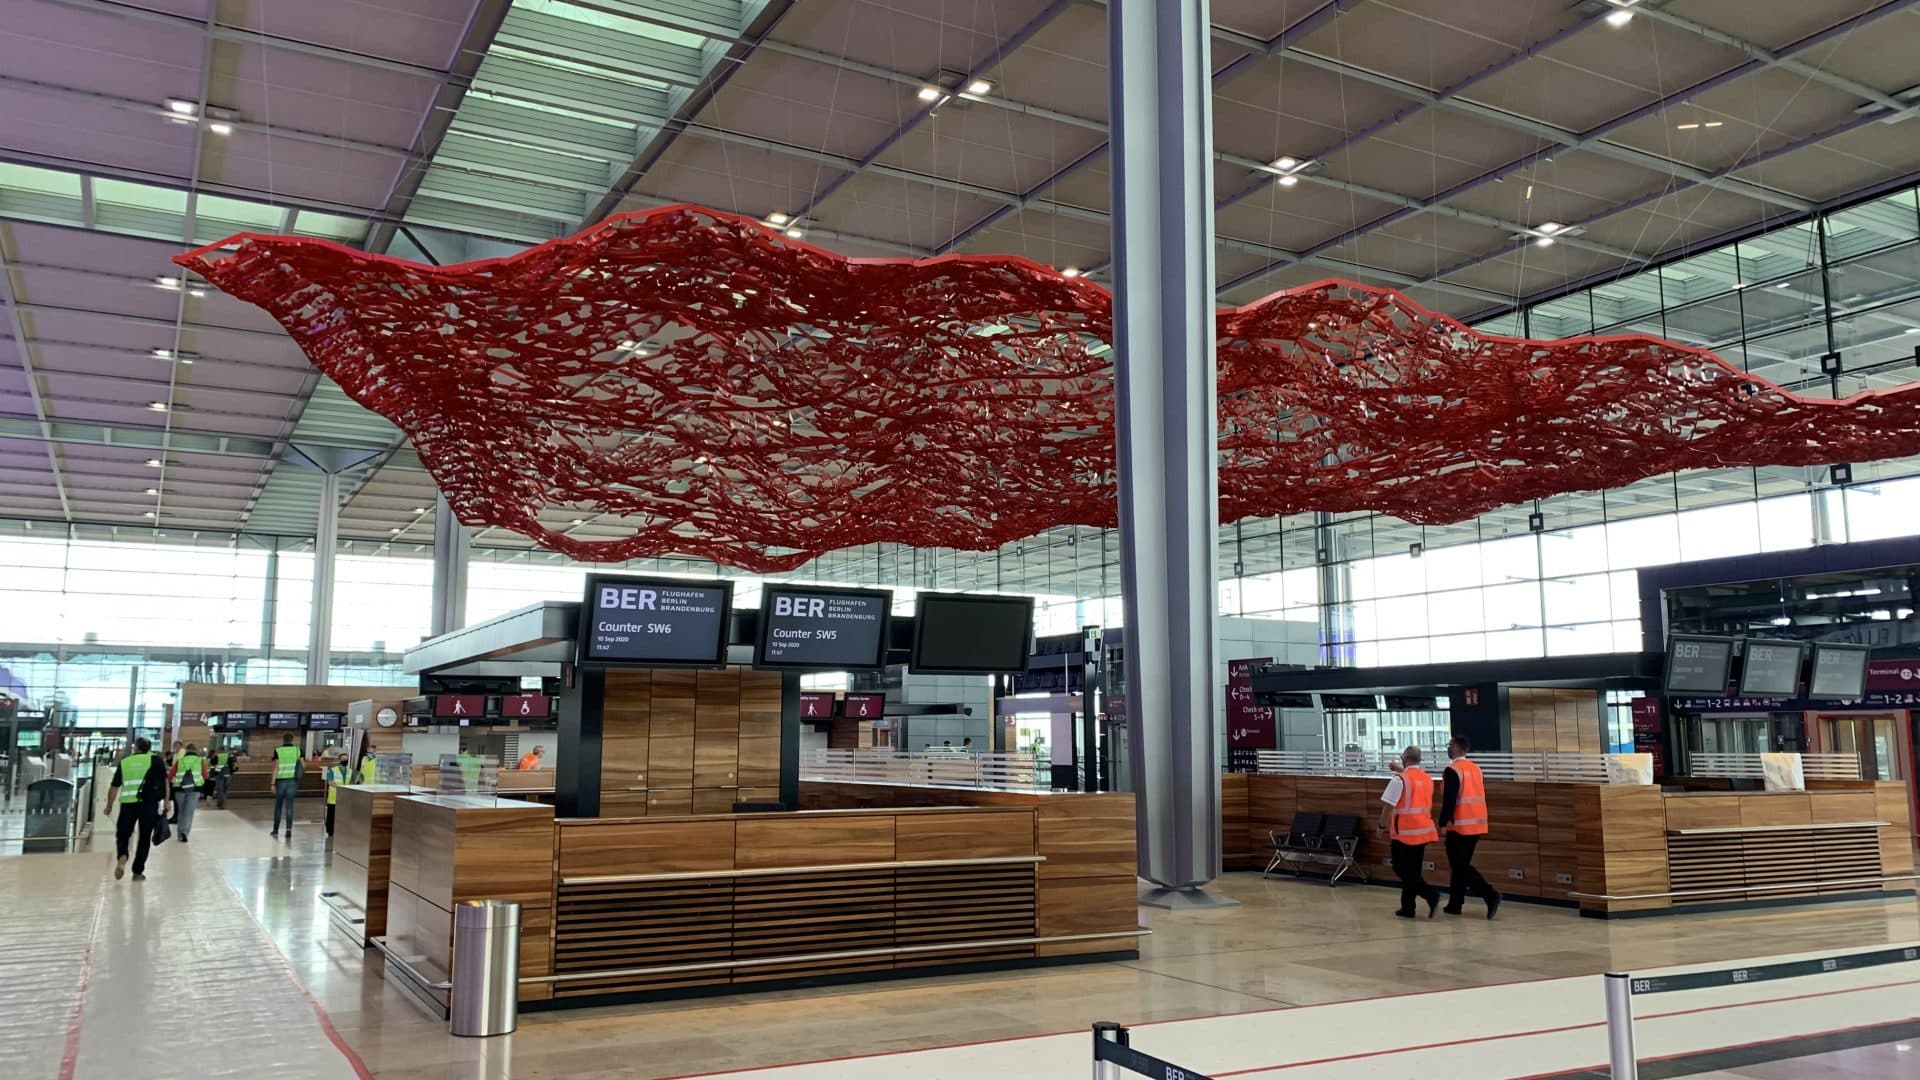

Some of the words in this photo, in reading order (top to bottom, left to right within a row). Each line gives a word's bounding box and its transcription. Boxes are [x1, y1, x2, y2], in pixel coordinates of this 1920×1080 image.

[600, 587, 656, 610] BER
[662, 590, 705, 598] FLUGHAFEN
[660, 605, 716, 613] BRANDENBURG
[775, 596, 825, 618] BER
[598, 621, 643, 633] Counter
[647, 623, 672, 634] SW6
[773, 628, 812, 639] Counter
[1675, 643, 1700, 659] BER
[1750, 648, 1773, 662] BER
[1870, 668, 1900, 676] Terminal
[1732, 970, 1749, 982] BER
[1634, 980, 1651, 992] BER
